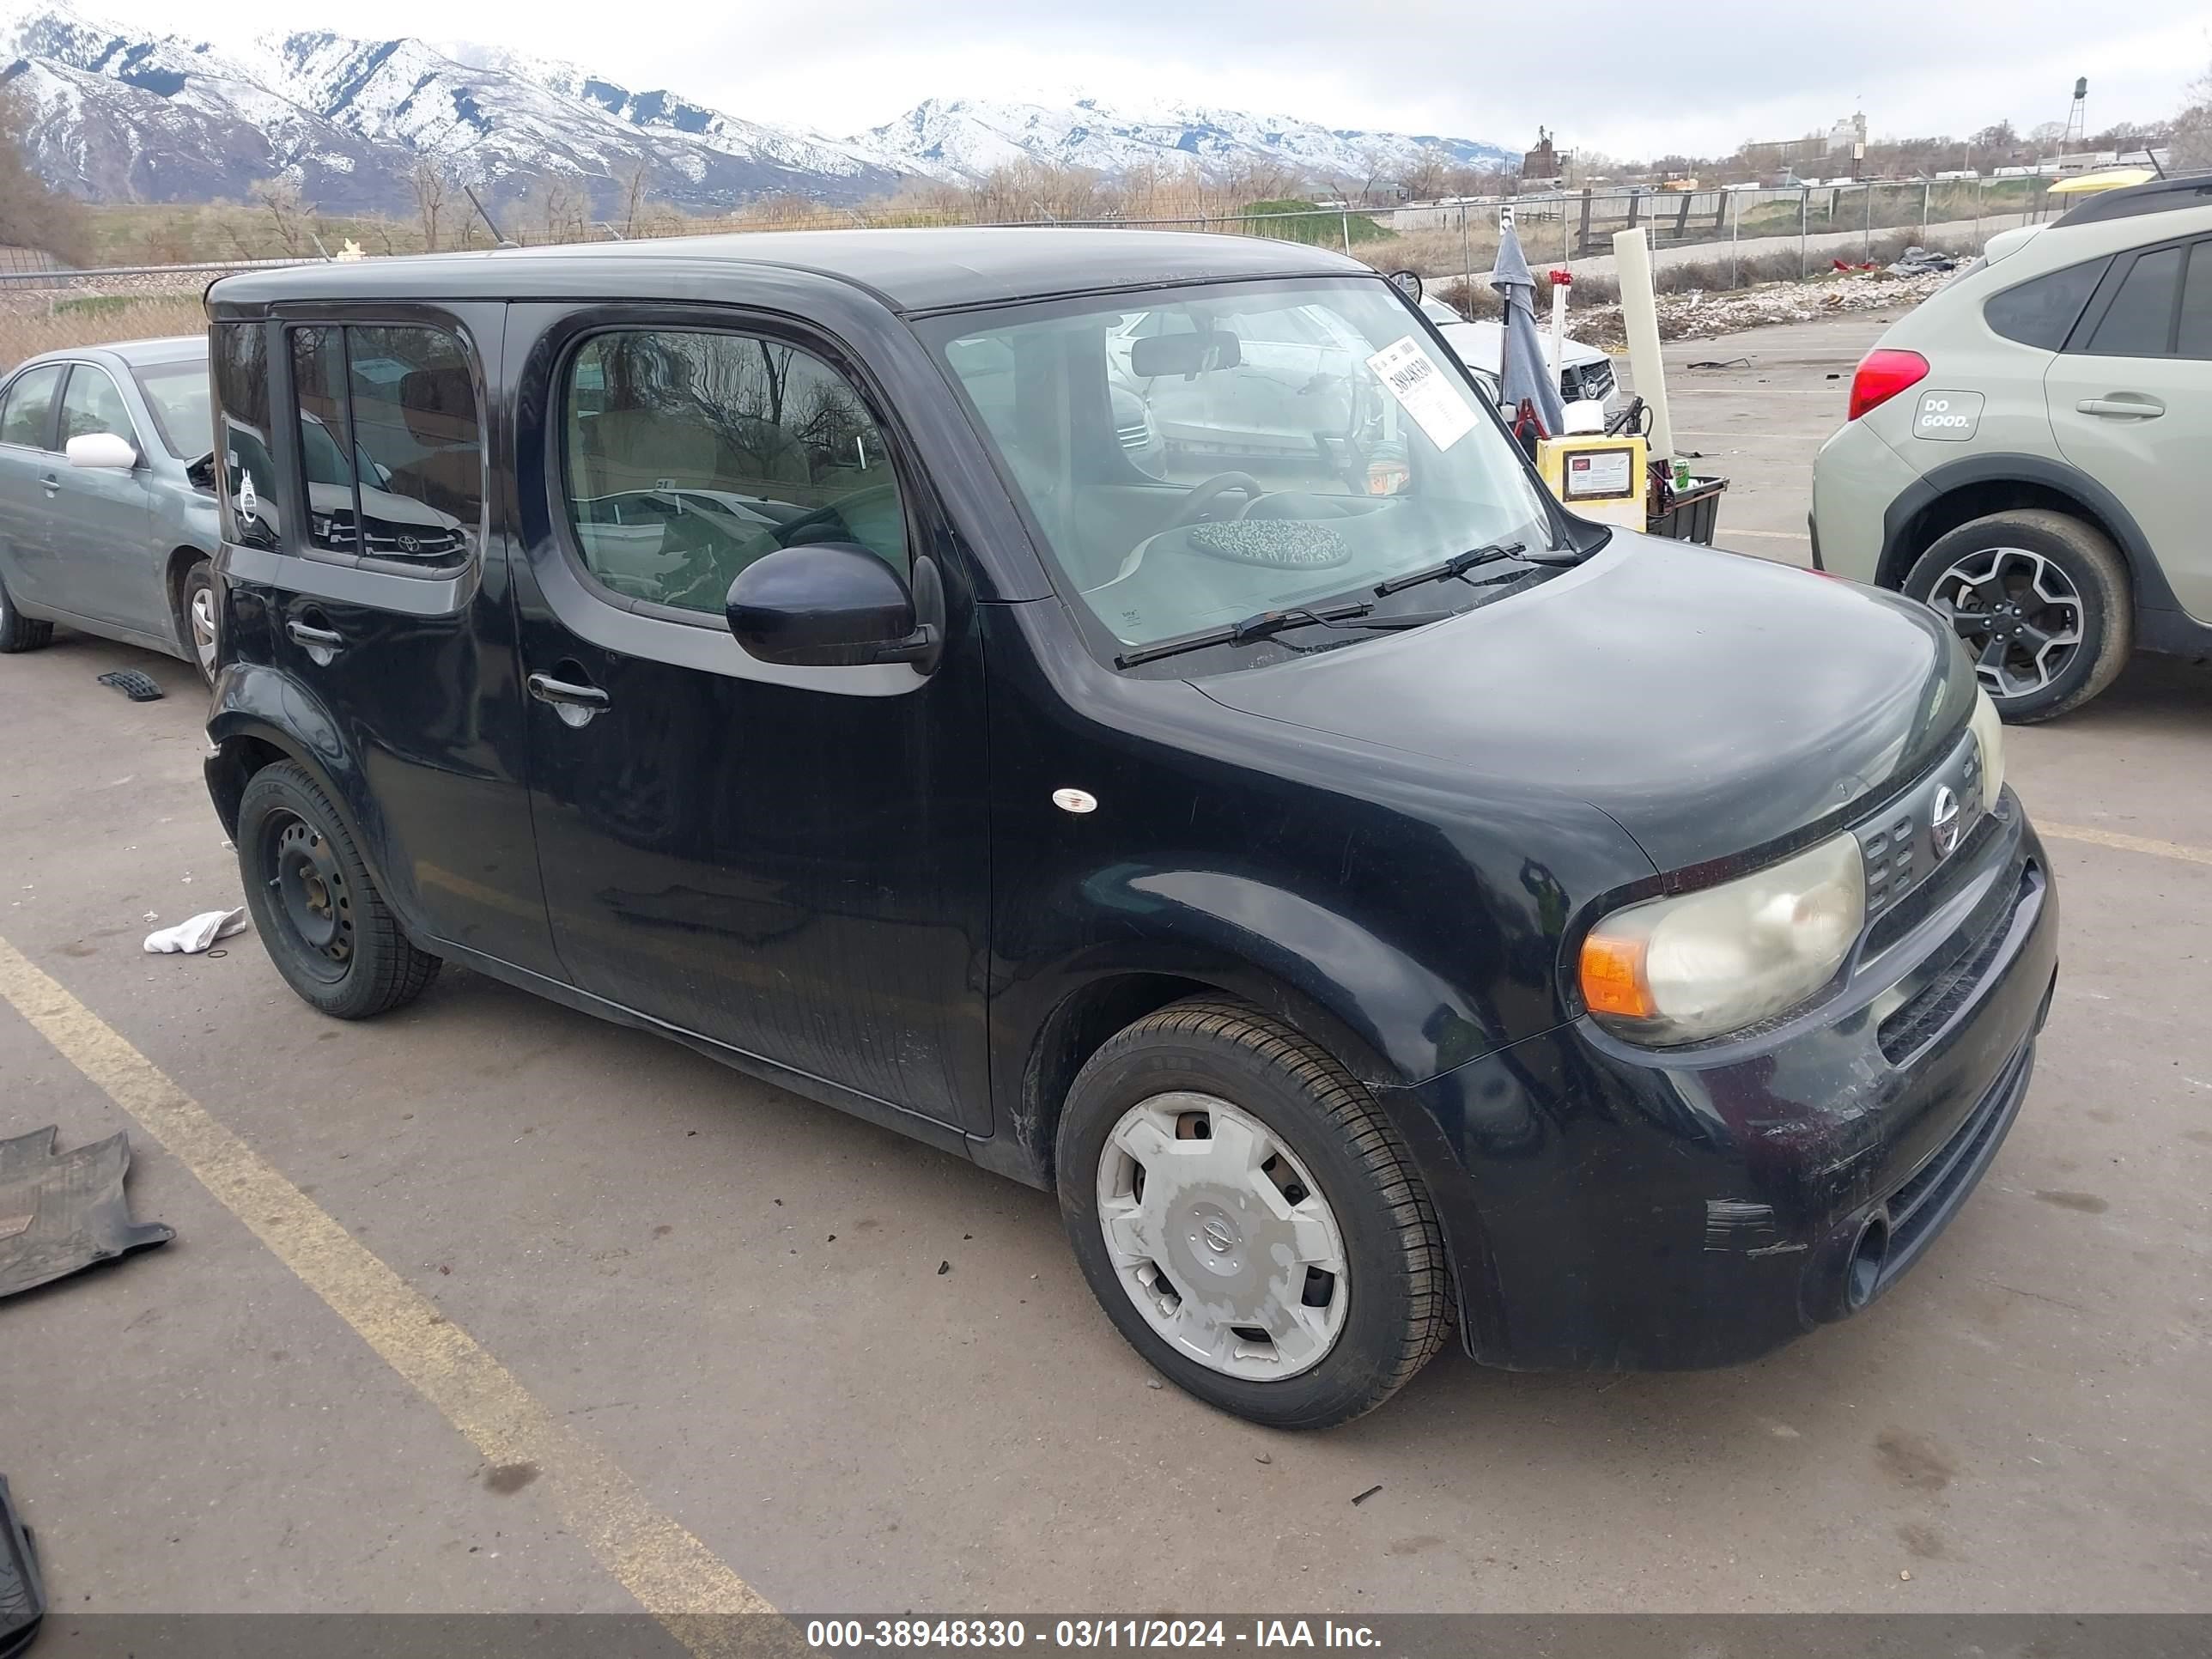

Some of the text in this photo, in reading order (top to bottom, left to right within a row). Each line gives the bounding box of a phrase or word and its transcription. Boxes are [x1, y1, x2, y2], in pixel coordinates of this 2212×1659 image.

[1501, 206, 1512, 231] 5
[1389, 357, 1432, 393] 38948330
[1924, 399, 1948, 412] DO
[1922, 415, 1970, 428] GOOD.
